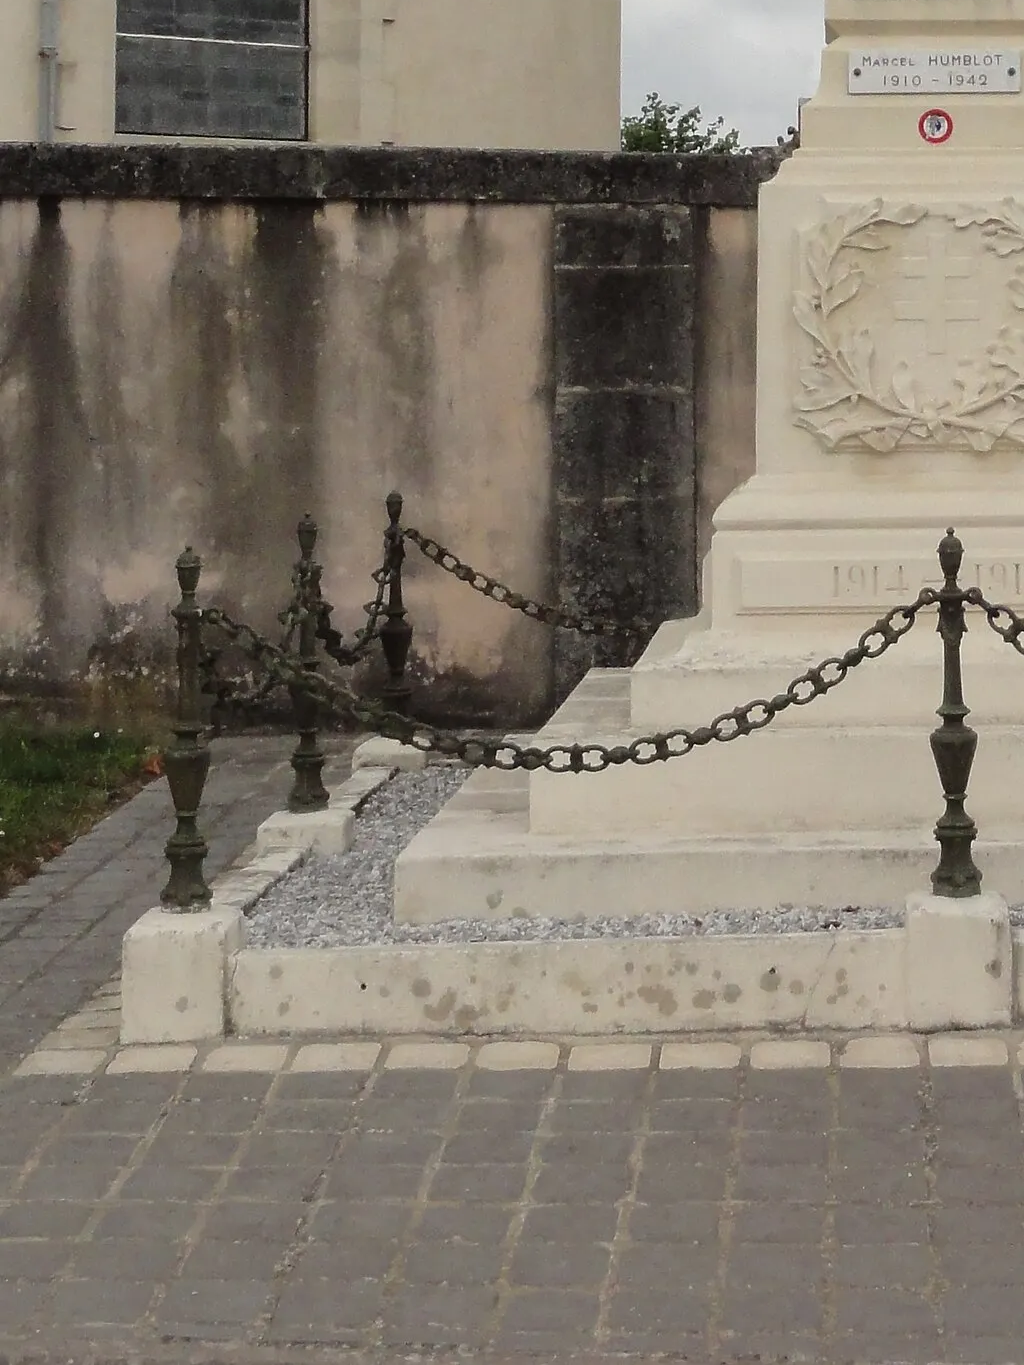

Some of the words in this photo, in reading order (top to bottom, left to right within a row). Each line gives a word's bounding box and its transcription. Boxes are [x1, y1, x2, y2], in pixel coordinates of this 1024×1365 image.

[928, 54, 1003, 67] HUMBLOT
[882, 75, 922, 87] 1910
[949, 74, 988, 86] 1942
[832, 564, 910, 597] 1914
